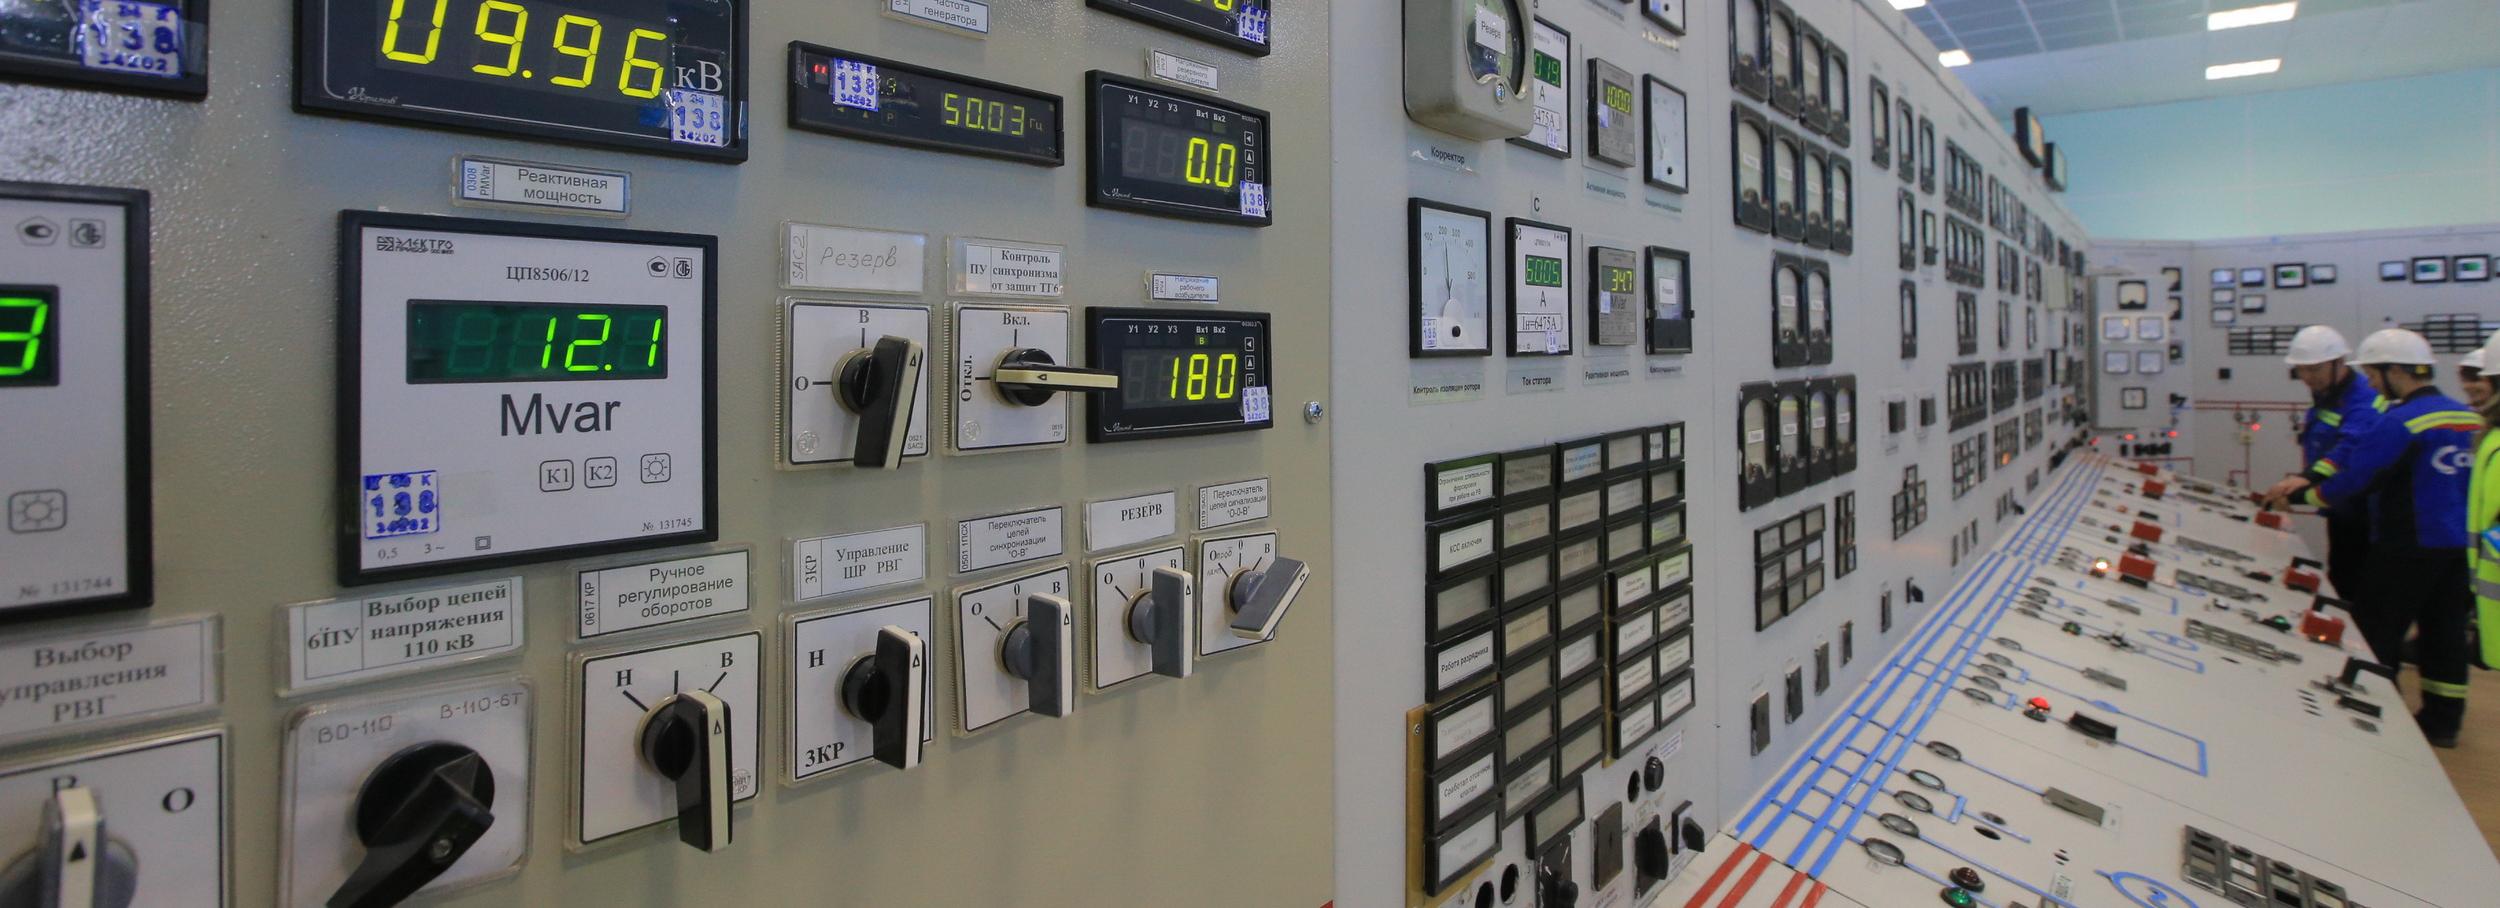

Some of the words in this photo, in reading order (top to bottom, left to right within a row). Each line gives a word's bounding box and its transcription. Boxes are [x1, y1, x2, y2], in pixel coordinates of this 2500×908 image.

[924, 7, 977, 26] генератора
[674, 58, 723, 92] кВ
[675, 105, 721, 131] 138
[944, 92, 1025, 136] 50.03
[1186, 137, 1236, 187] 0.0
[1431, 145, 1465, 164] Корректор
[480, 165, 491, 196] PMVar
[518, 168, 608, 190] Реактивная
[524, 188, 602, 205] мощность
[1243, 192, 1262, 207] 138
[821, 246, 897, 274] Резерв
[1001, 250, 1051, 264] Контроль
[506, 266, 590, 282] ЦП8506/12
[970, 263, 987, 274] ПУ
[993, 267, 1058, 279] синхронизма
[1006, 284, 1036, 292] защит
[859, 310, 870, 323] В
[1002, 312, 1030, 326] Вкл.
[541, 313, 662, 372] 12.1
[961, 355, 973, 401] Откл.
[1171, 354, 1237, 400] 180
[1522, 376, 1532, 386] Ток
[1532, 377, 1551, 386] статора
[501, 393, 621, 437] Mvar
[1213, 485, 1264, 500] Переключатель
[1121, 503, 1163, 522] РЕЗЕРВ
[660, 517, 692, 531] 131745
[989, 516, 1046, 530] Переключатель
[1007, 527, 1030, 539] цепей
[836, 542, 910, 562] Управление
[990, 536, 1046, 552] синхронизации
[649, 564, 705, 583] Ручное
[844, 564, 866, 579] ШР
[877, 558, 903, 575] РВГ
[618, 577, 733, 608] регулирование
[1052, 581, 1060, 594] В
[368, 598, 441, 618] Выбор
[448, 586, 506, 607] цепей
[641, 597, 713, 618] оборотов
[370, 610, 505, 640] напряжения
[34, 641, 133, 668] Выбор
[405, 639, 439, 658] 110
[446, 634, 475, 652] кВ
[720, 651, 734, 669] В
[808, 649, 824, 669] Н
[1441, 659, 1460, 673] Работа
[615, 668, 632, 687] Н
[53, 694, 117, 723] РВГ
